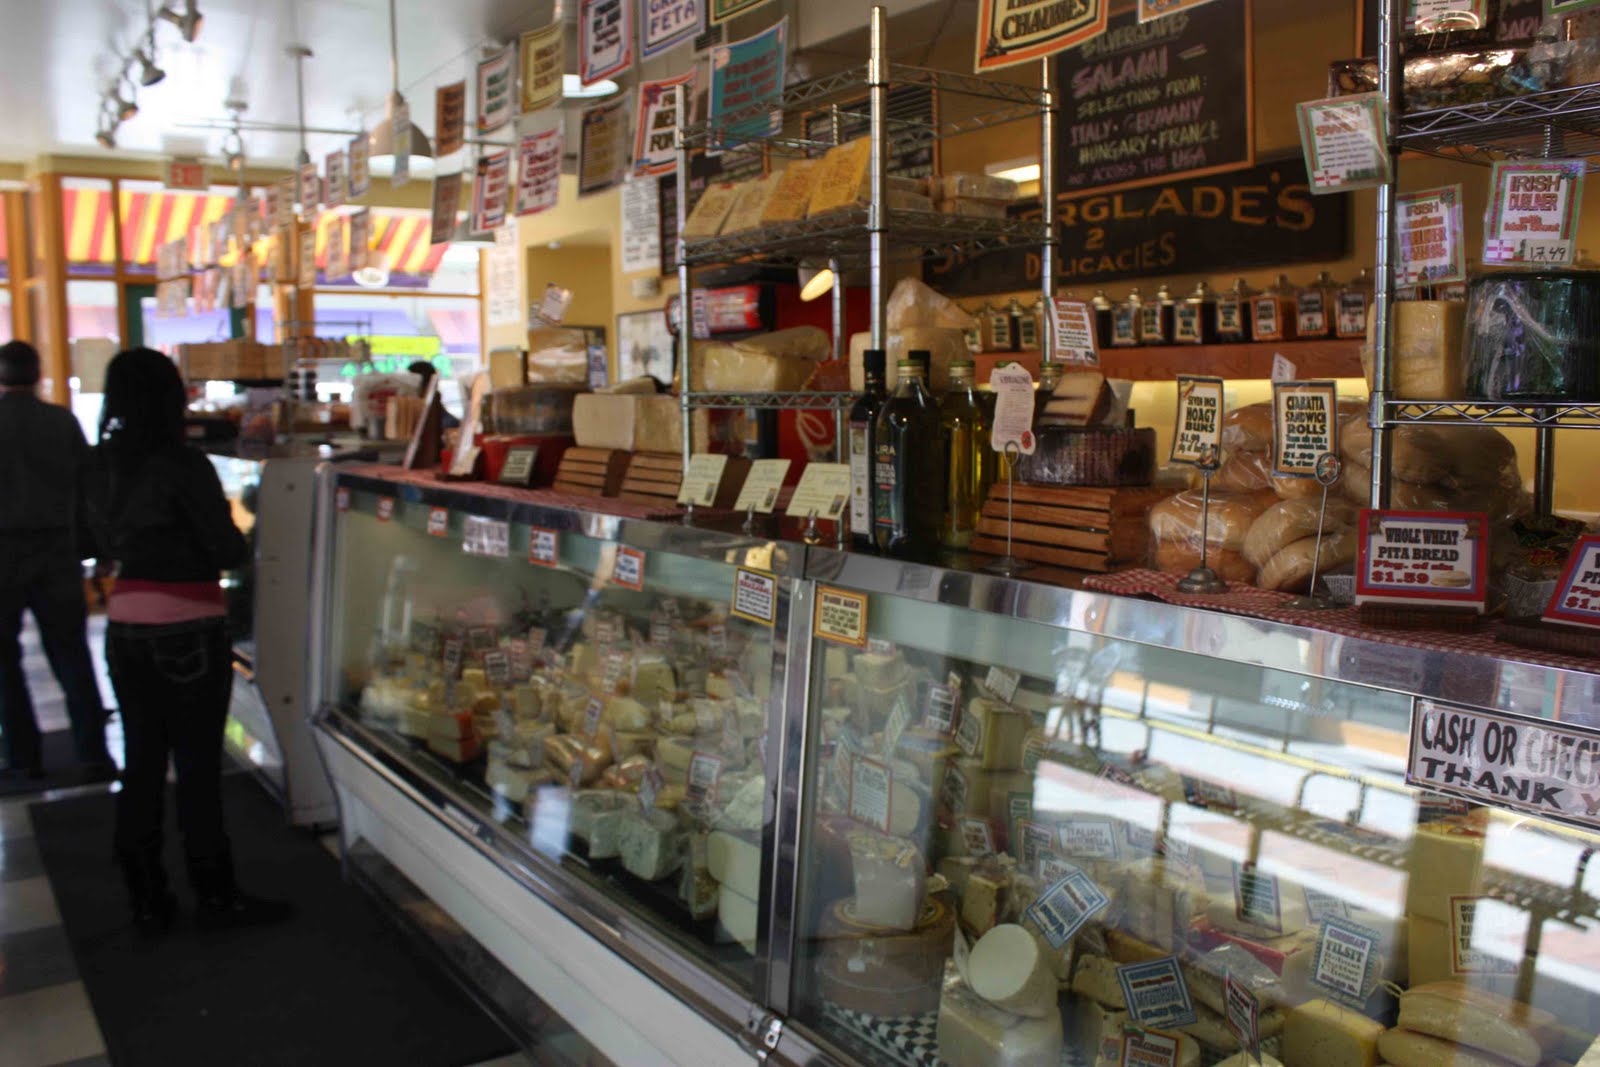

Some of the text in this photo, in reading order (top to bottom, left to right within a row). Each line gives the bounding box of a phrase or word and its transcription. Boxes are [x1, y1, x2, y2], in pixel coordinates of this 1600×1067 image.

[650, 1, 696, 36] FETA
[1071, 46, 1168, 99] SALAMI
[1079, 120, 1220, 165] HUNGARY FRANCE
[1509, 175, 1561, 192] IRISH
[1508, 193, 1558, 211] DUBLINER
[1025, 231, 1177, 281] DLICACIES
[1286, 396, 1325, 410] CIABATTA
[1187, 407, 1216, 423] HOAGY
[1285, 412, 1326, 423] SANDWICH
[1185, 421, 1215, 433] BUNS
[1287, 424, 1327, 435] ROLLS
[1385, 527, 1459, 545] WHOLE WHEAT
[1378, 546, 1460, 561] PITA BREAD
[1371, 570, 1430, 585] $1.59
[1421, 712, 1476, 758] CASH
[1483, 721, 1517, 767] OR
[1420, 757, 1564, 810] THANK
[1326, 940, 1365, 962] TILSIT
